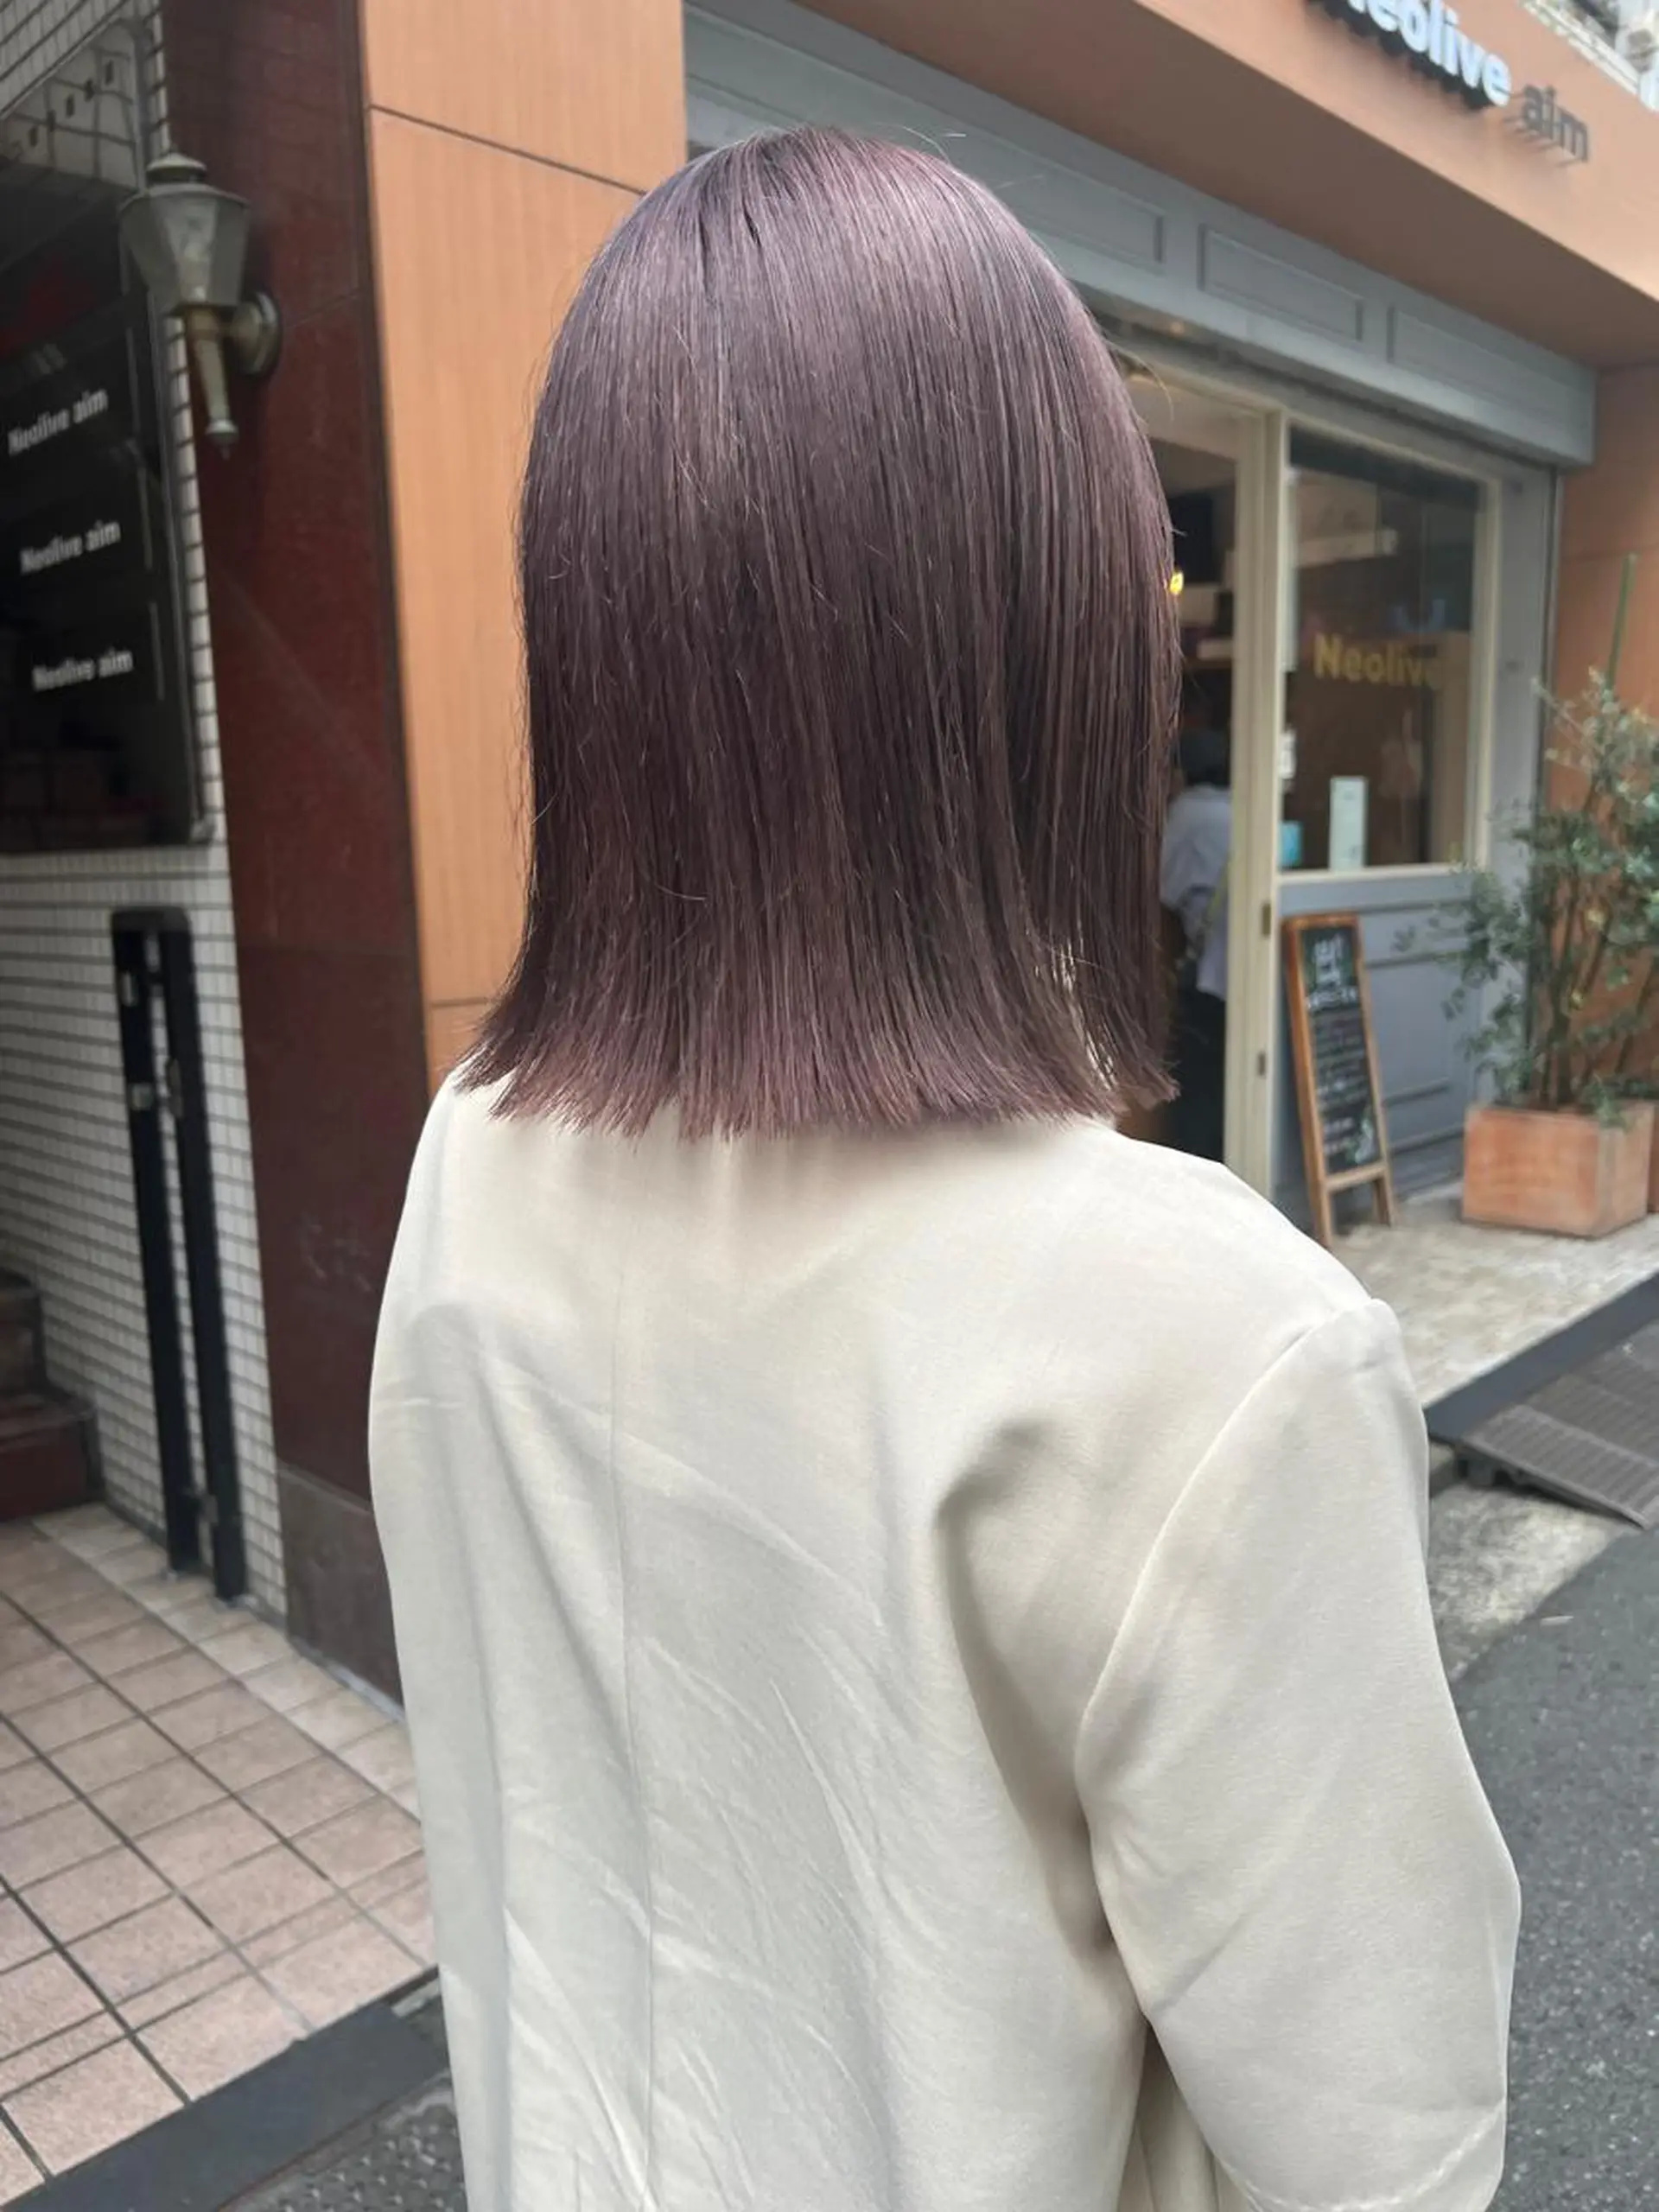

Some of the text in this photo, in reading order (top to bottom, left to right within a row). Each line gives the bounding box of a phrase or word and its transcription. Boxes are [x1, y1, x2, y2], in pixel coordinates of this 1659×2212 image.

[1339, 0, 1589, 162] eolive aim
[8, 389, 109, 457] Neolive aim
[21, 519, 121, 574] Neolive aim
[98, 647, 133, 678] aim
